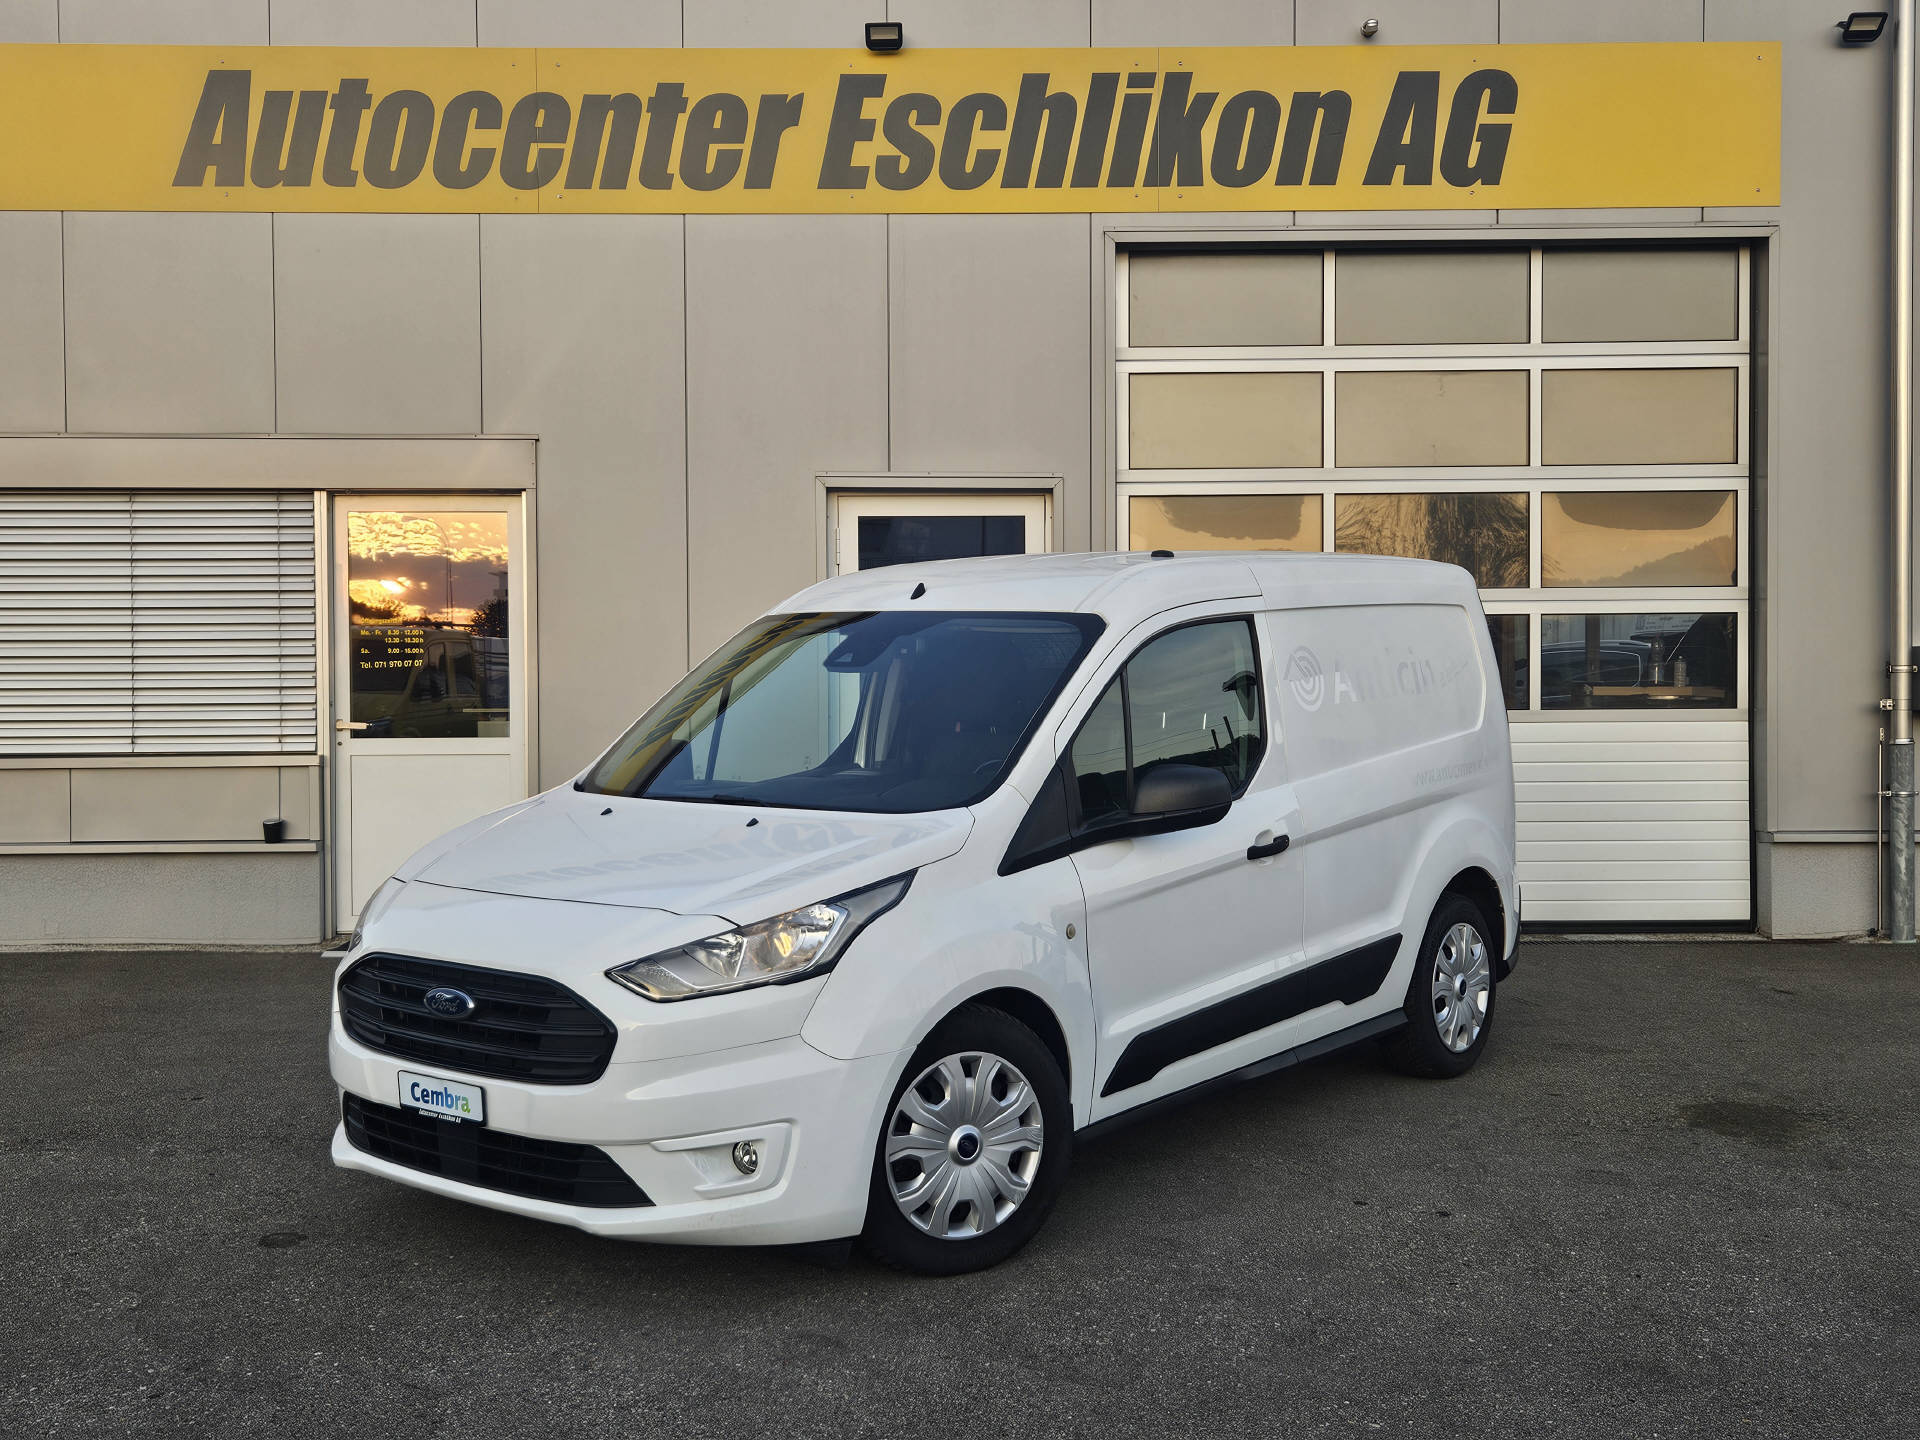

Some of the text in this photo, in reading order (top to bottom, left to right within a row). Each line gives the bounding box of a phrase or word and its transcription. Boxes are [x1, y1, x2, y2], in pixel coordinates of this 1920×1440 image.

[172, 69, 1519, 191] Autocenter Eschlikon AG
[360, 661, 373, 669] Tel.
[389, 660, 403, 668] 970
[404, 660, 413, 668] 07
[414, 659, 423, 667] 07
[431, 992, 460, 1013] Ford
[410, 1081, 471, 1113] Cembra
